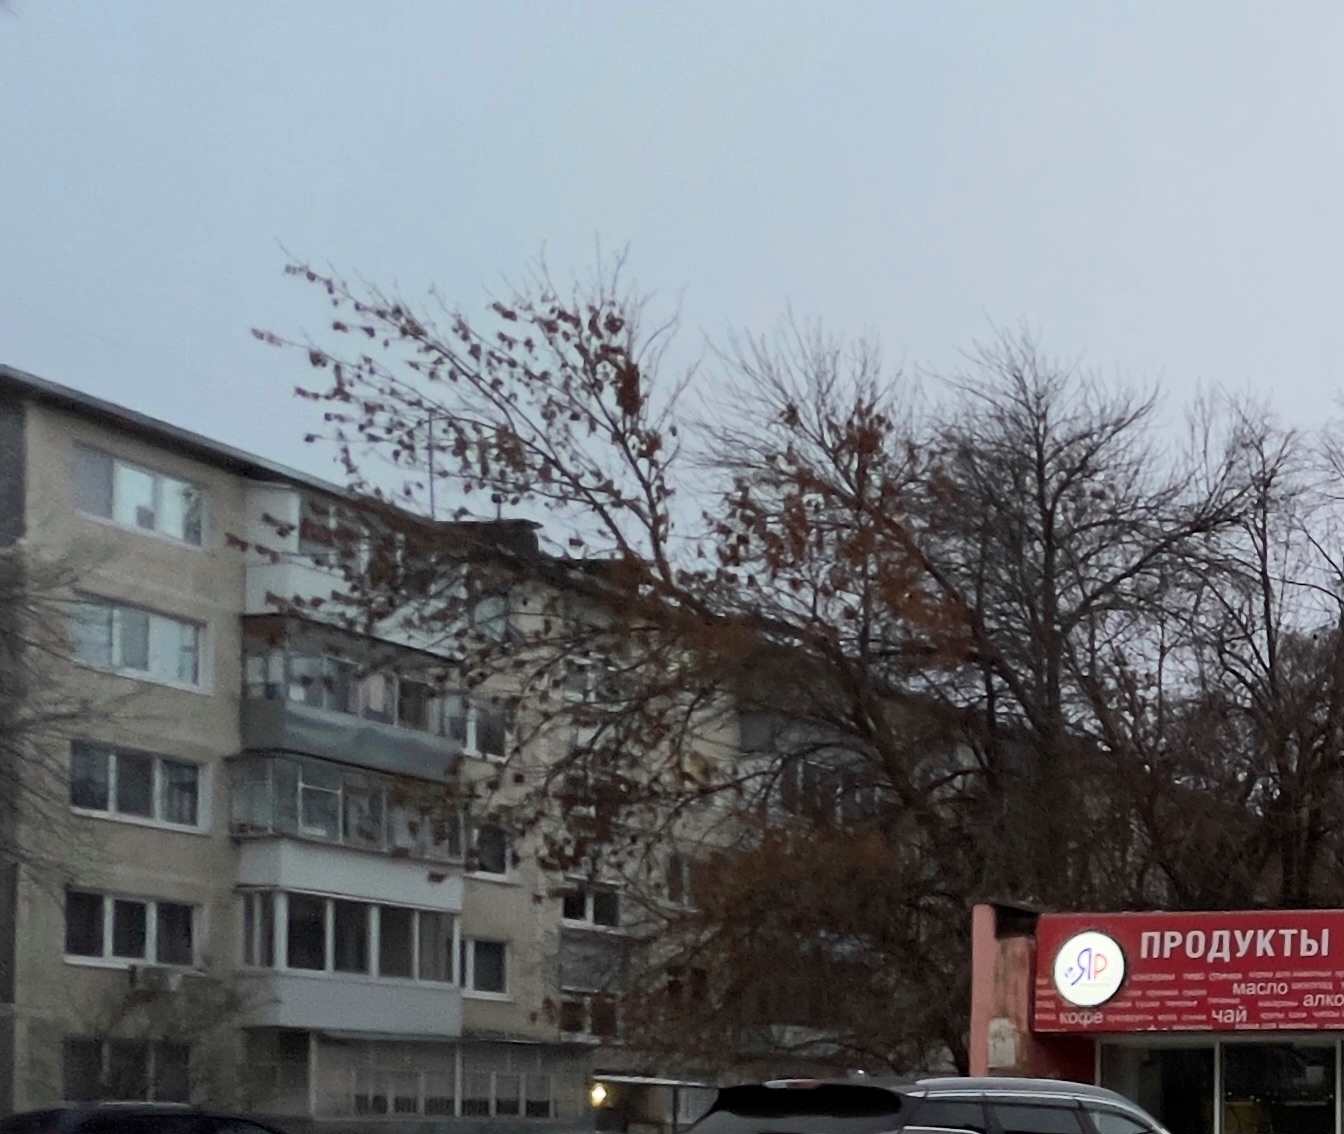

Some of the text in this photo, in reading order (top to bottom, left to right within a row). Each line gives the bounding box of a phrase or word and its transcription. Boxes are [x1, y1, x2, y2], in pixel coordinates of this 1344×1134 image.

[1141, 928, 1330, 963] ПРОДУКТЫ
[1232, 982, 1288, 995] масло
[1059, 1011, 1104, 1028] кофе
[1211, 1004, 1247, 1023] чай
